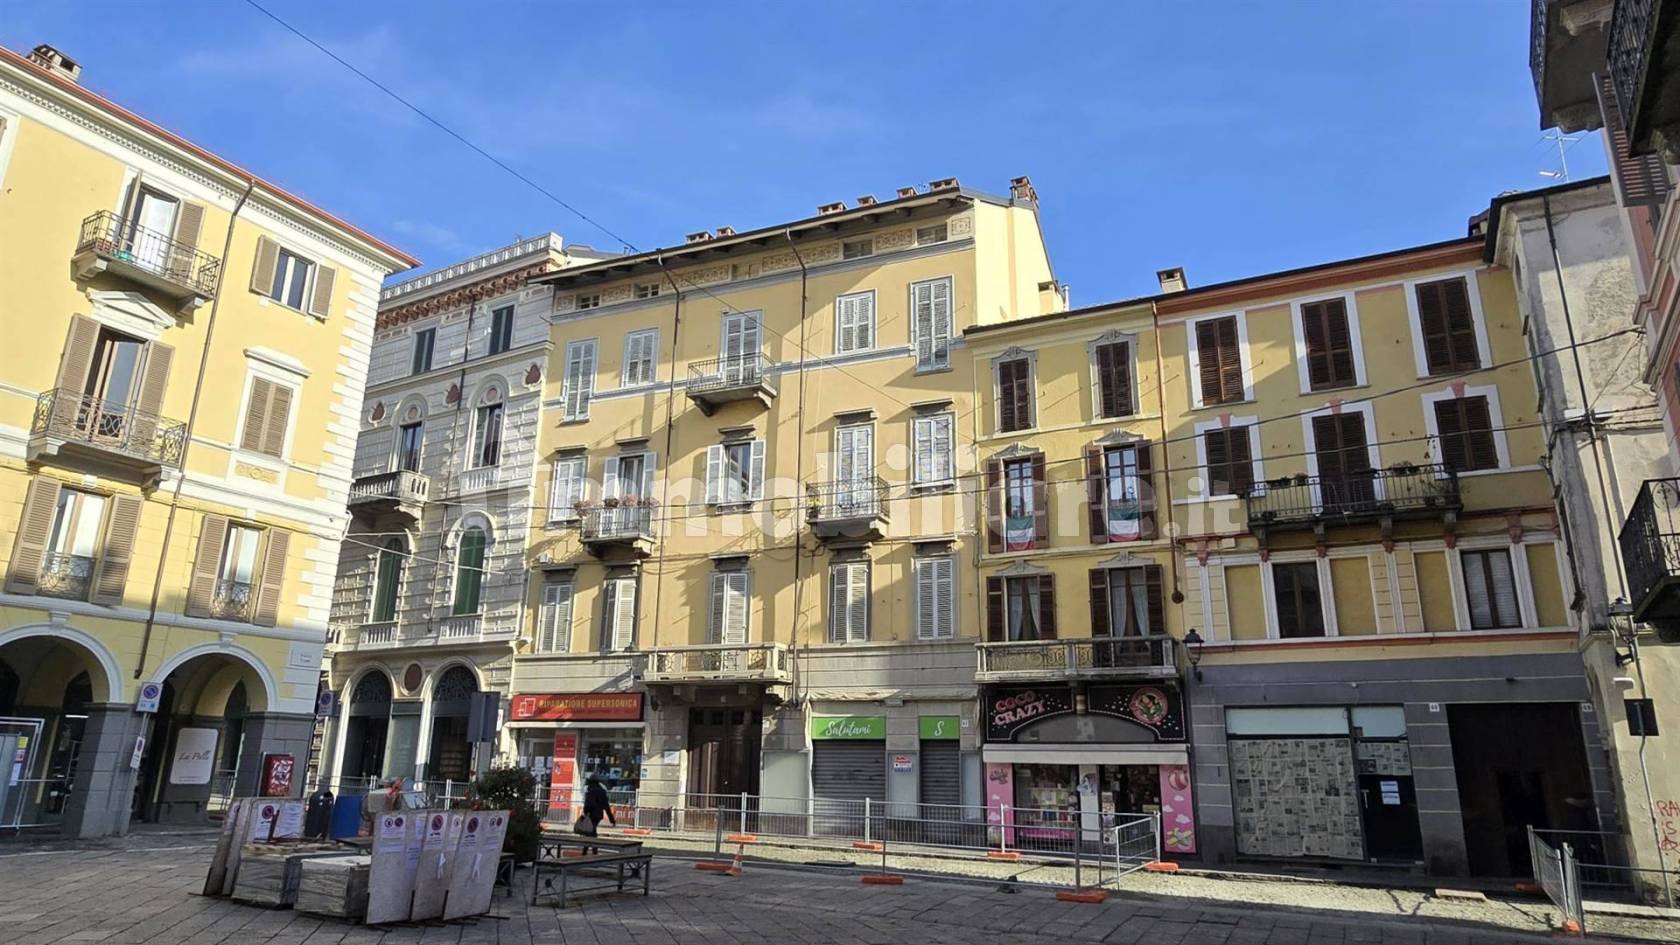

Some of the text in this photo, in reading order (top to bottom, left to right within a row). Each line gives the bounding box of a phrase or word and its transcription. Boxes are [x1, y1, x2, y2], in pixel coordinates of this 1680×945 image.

[587, 699, 637, 709] SUPERSONICA
[995, 690, 1036, 712] COCO
[994, 700, 1045, 725] CRAZY
[825, 720, 872, 737] Salutami
[934, 720, 945, 737] S
